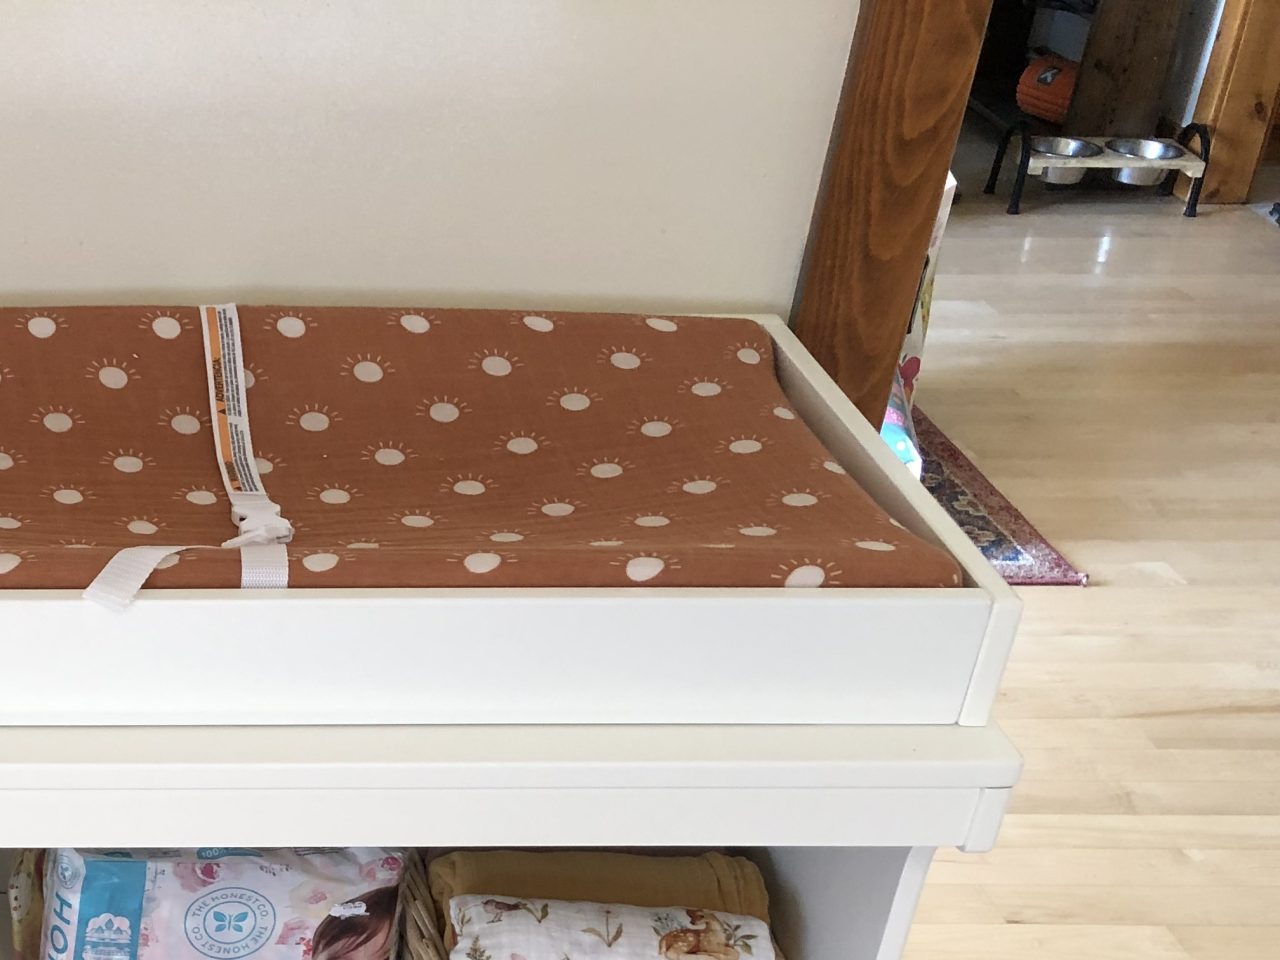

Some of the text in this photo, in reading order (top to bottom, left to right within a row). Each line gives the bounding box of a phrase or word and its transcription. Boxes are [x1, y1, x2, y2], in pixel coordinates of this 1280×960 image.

[192, 901, 210, 917] THE
[210, 892, 260, 905] HONEST
[251, 926, 269, 945] THE
[201, 941, 251, 954] HONEST
